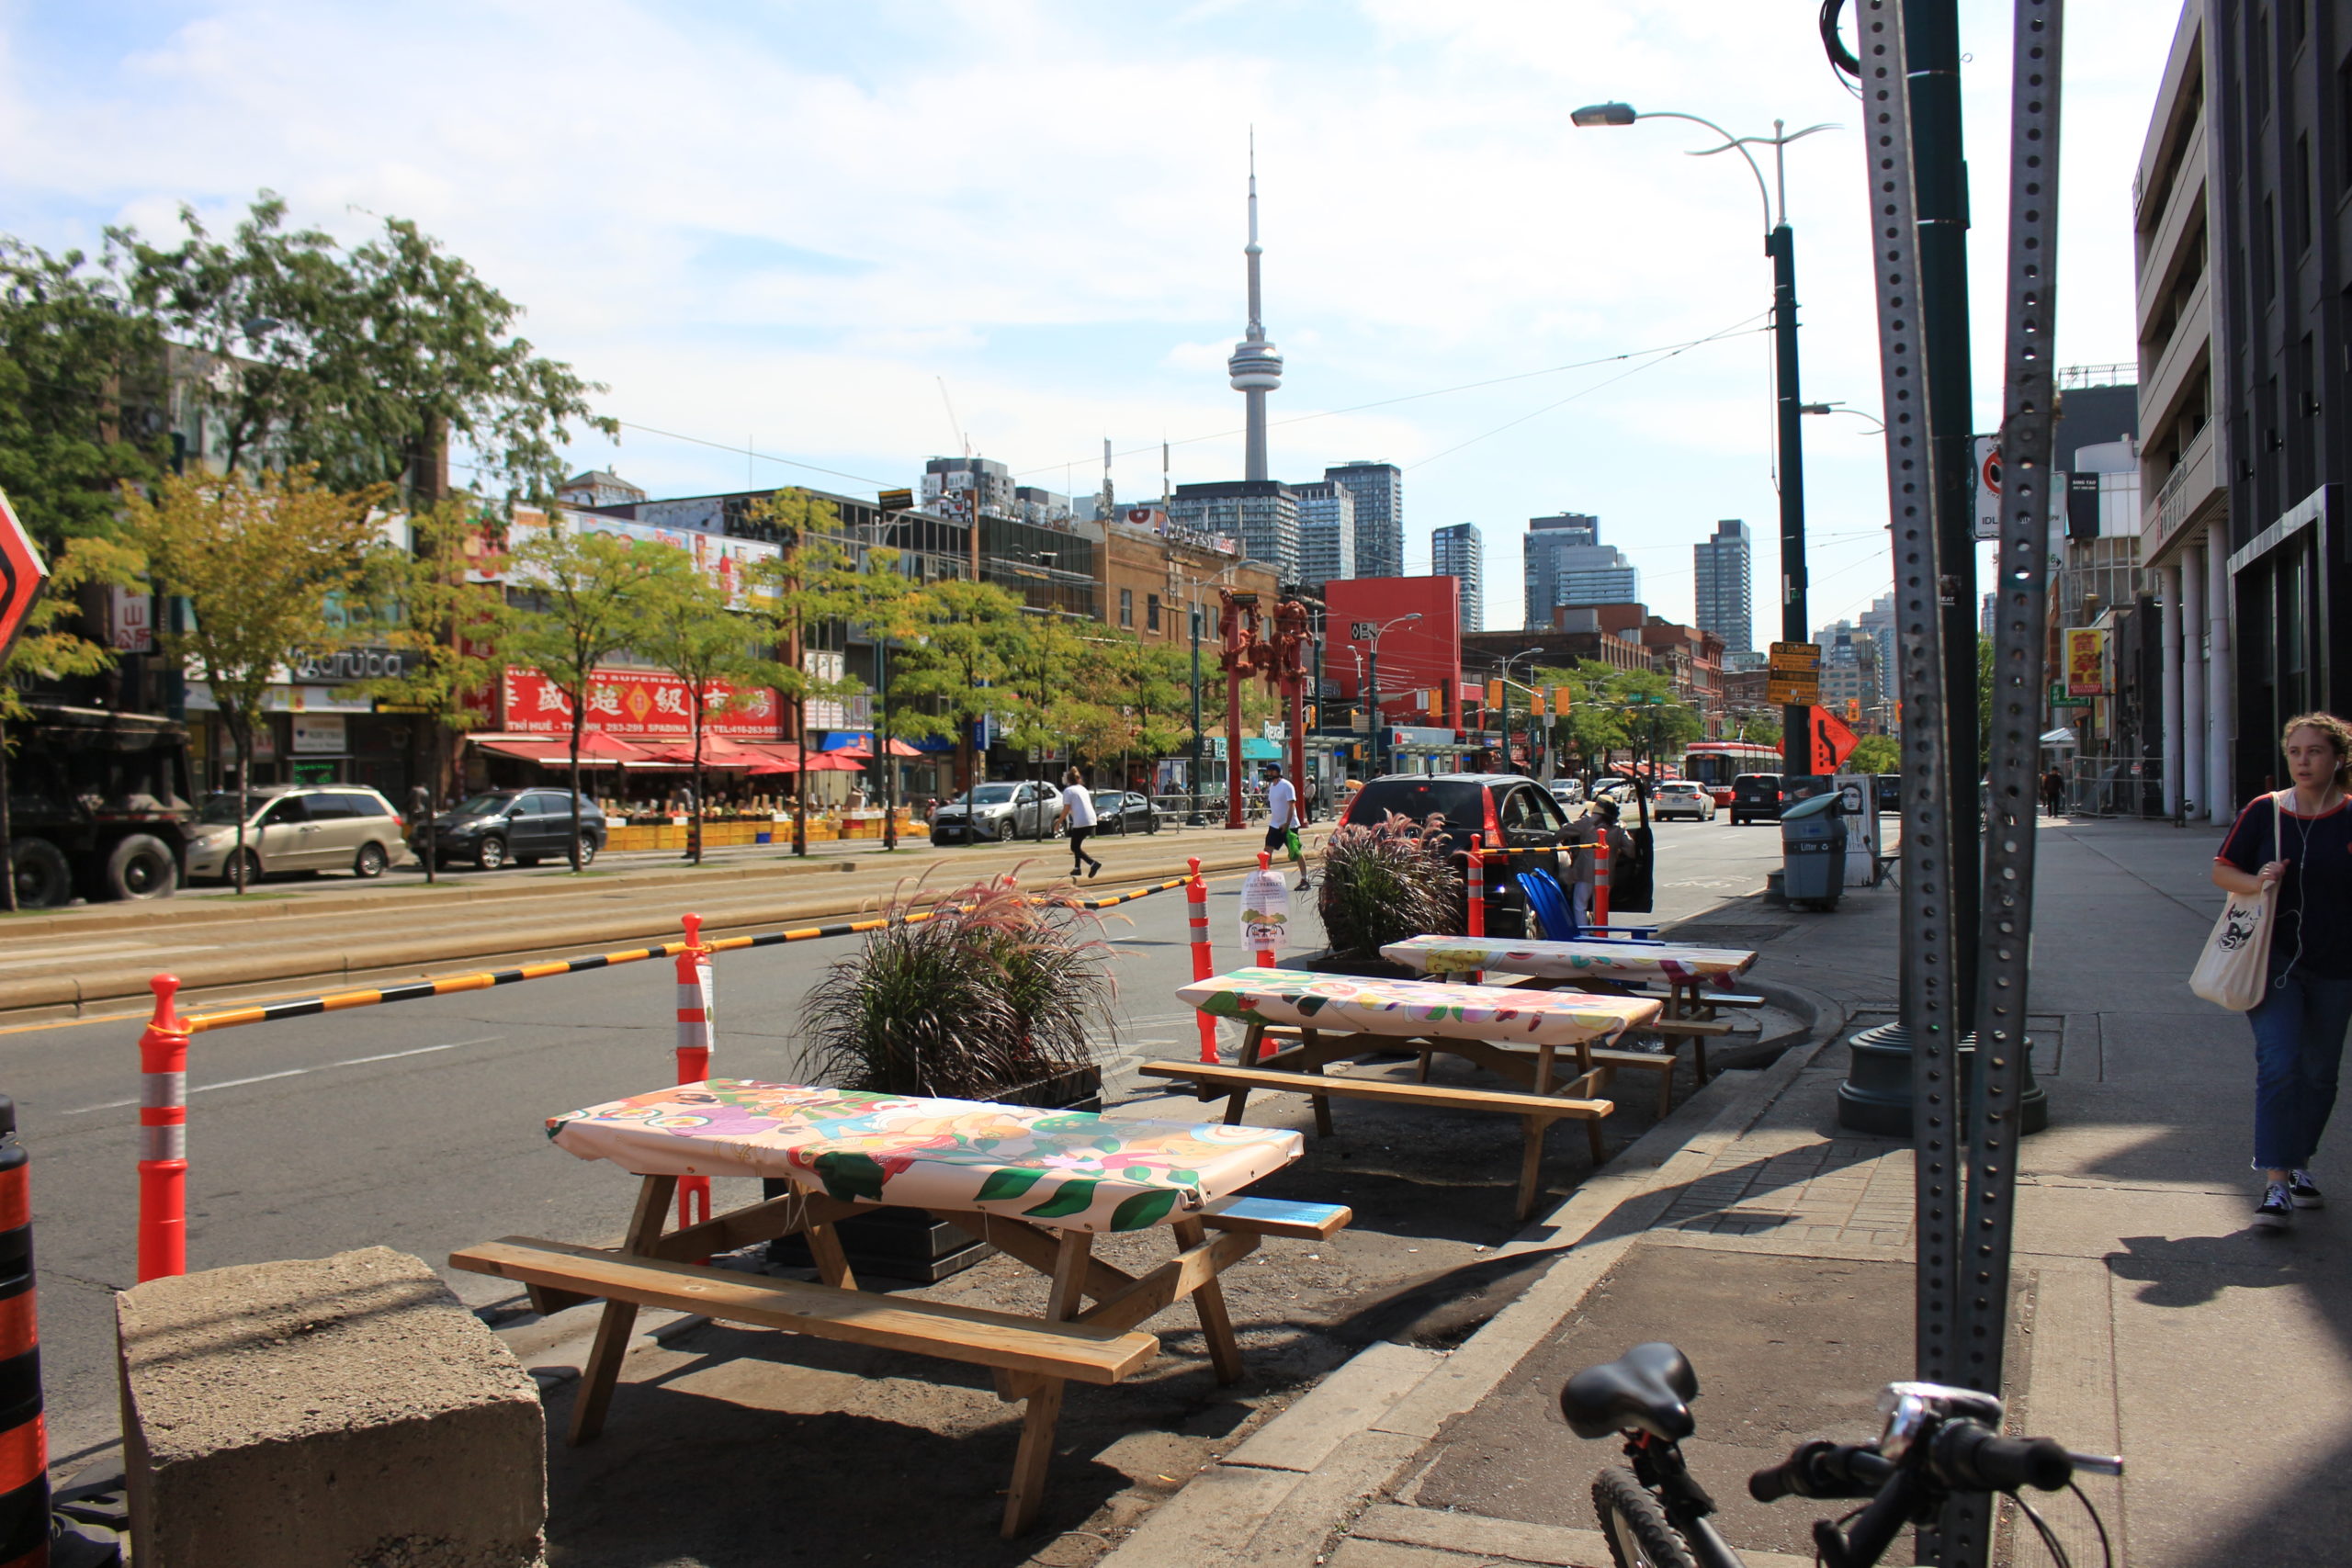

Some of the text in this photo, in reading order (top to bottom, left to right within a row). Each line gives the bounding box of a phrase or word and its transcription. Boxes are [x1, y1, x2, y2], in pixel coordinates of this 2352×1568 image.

[1982, 516, 1998, 525] IDL
[1773, 645, 1819, 655] NO DUMPING
[321, 649, 402, 678] aruba
[561, 721, 602, 733] THNH
[647, 723, 688, 733] SPADINA
[1801, 842, 1817, 852] Litter
